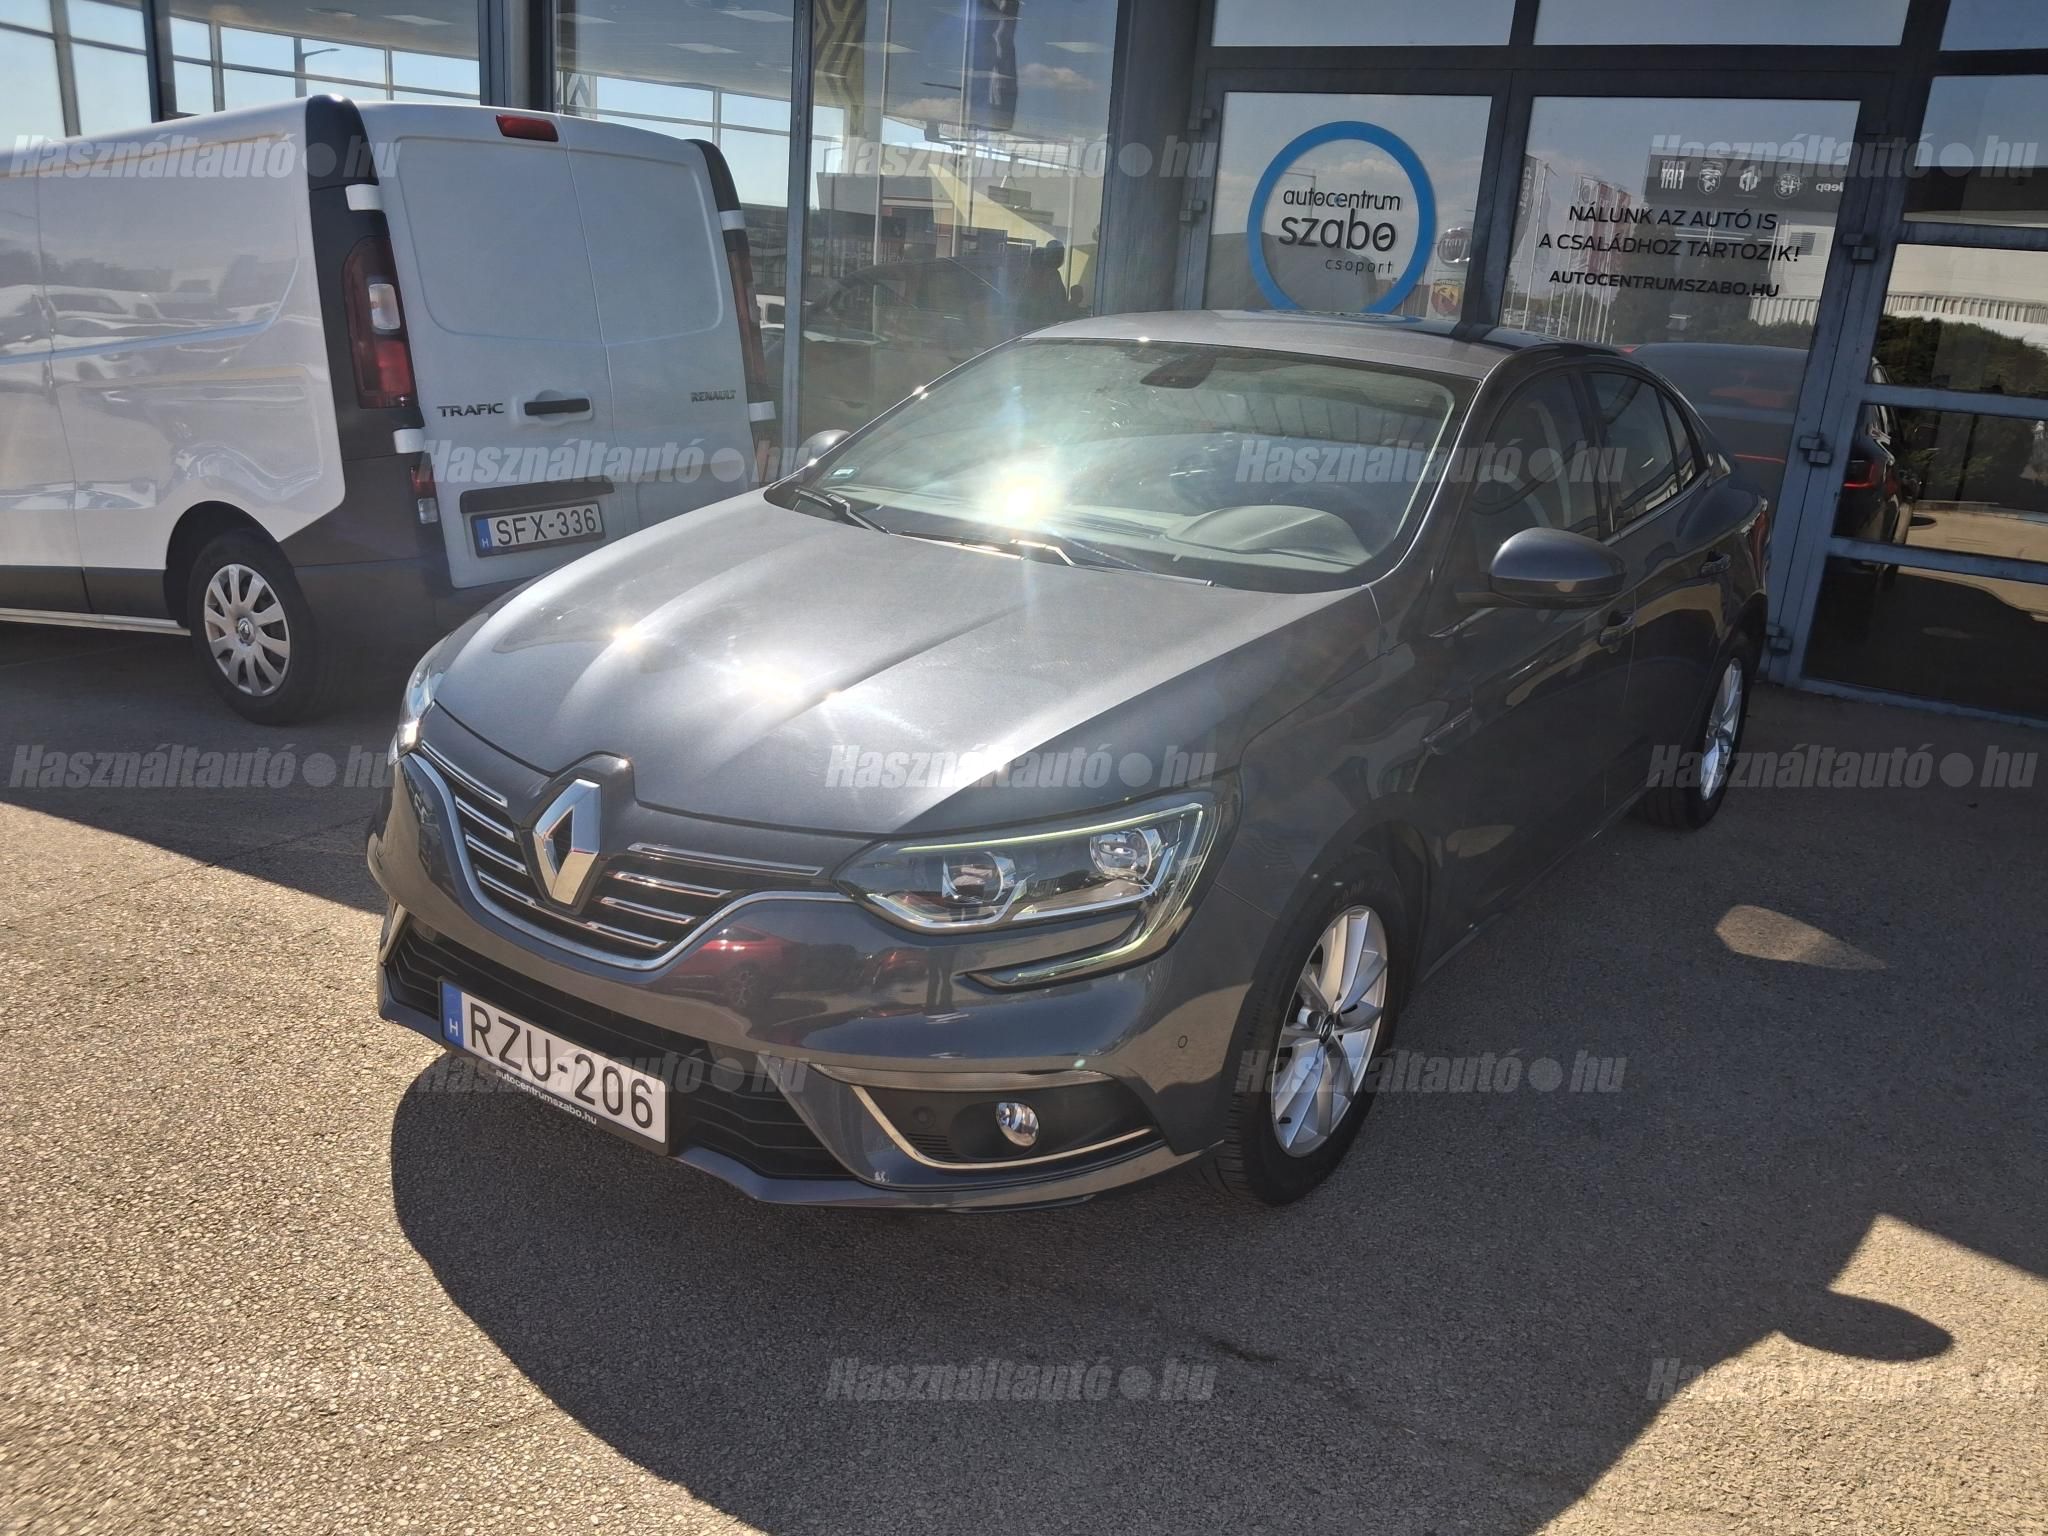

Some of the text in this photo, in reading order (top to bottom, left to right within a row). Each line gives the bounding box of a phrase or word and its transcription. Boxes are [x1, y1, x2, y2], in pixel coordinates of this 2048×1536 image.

[1283, 187, 1401, 211] autocentrum
[1569, 201, 1778, 230] NÁLUNK AZ AUTÓ IS
[1539, 233, 1801, 262] A CSALÁDHOZ TARTOZIK!
[1325, 257, 1394, 275] csoport
[1549, 270, 1780, 298] AUTOCENTRUMSZABO.HU
[436, 402, 505, 417] TRAFIC
[495, 507, 597, 546] SFX-336
[470, 1002, 653, 1129] RZU-206
[494, 1069, 598, 1126] autocentrumszabo.hu
